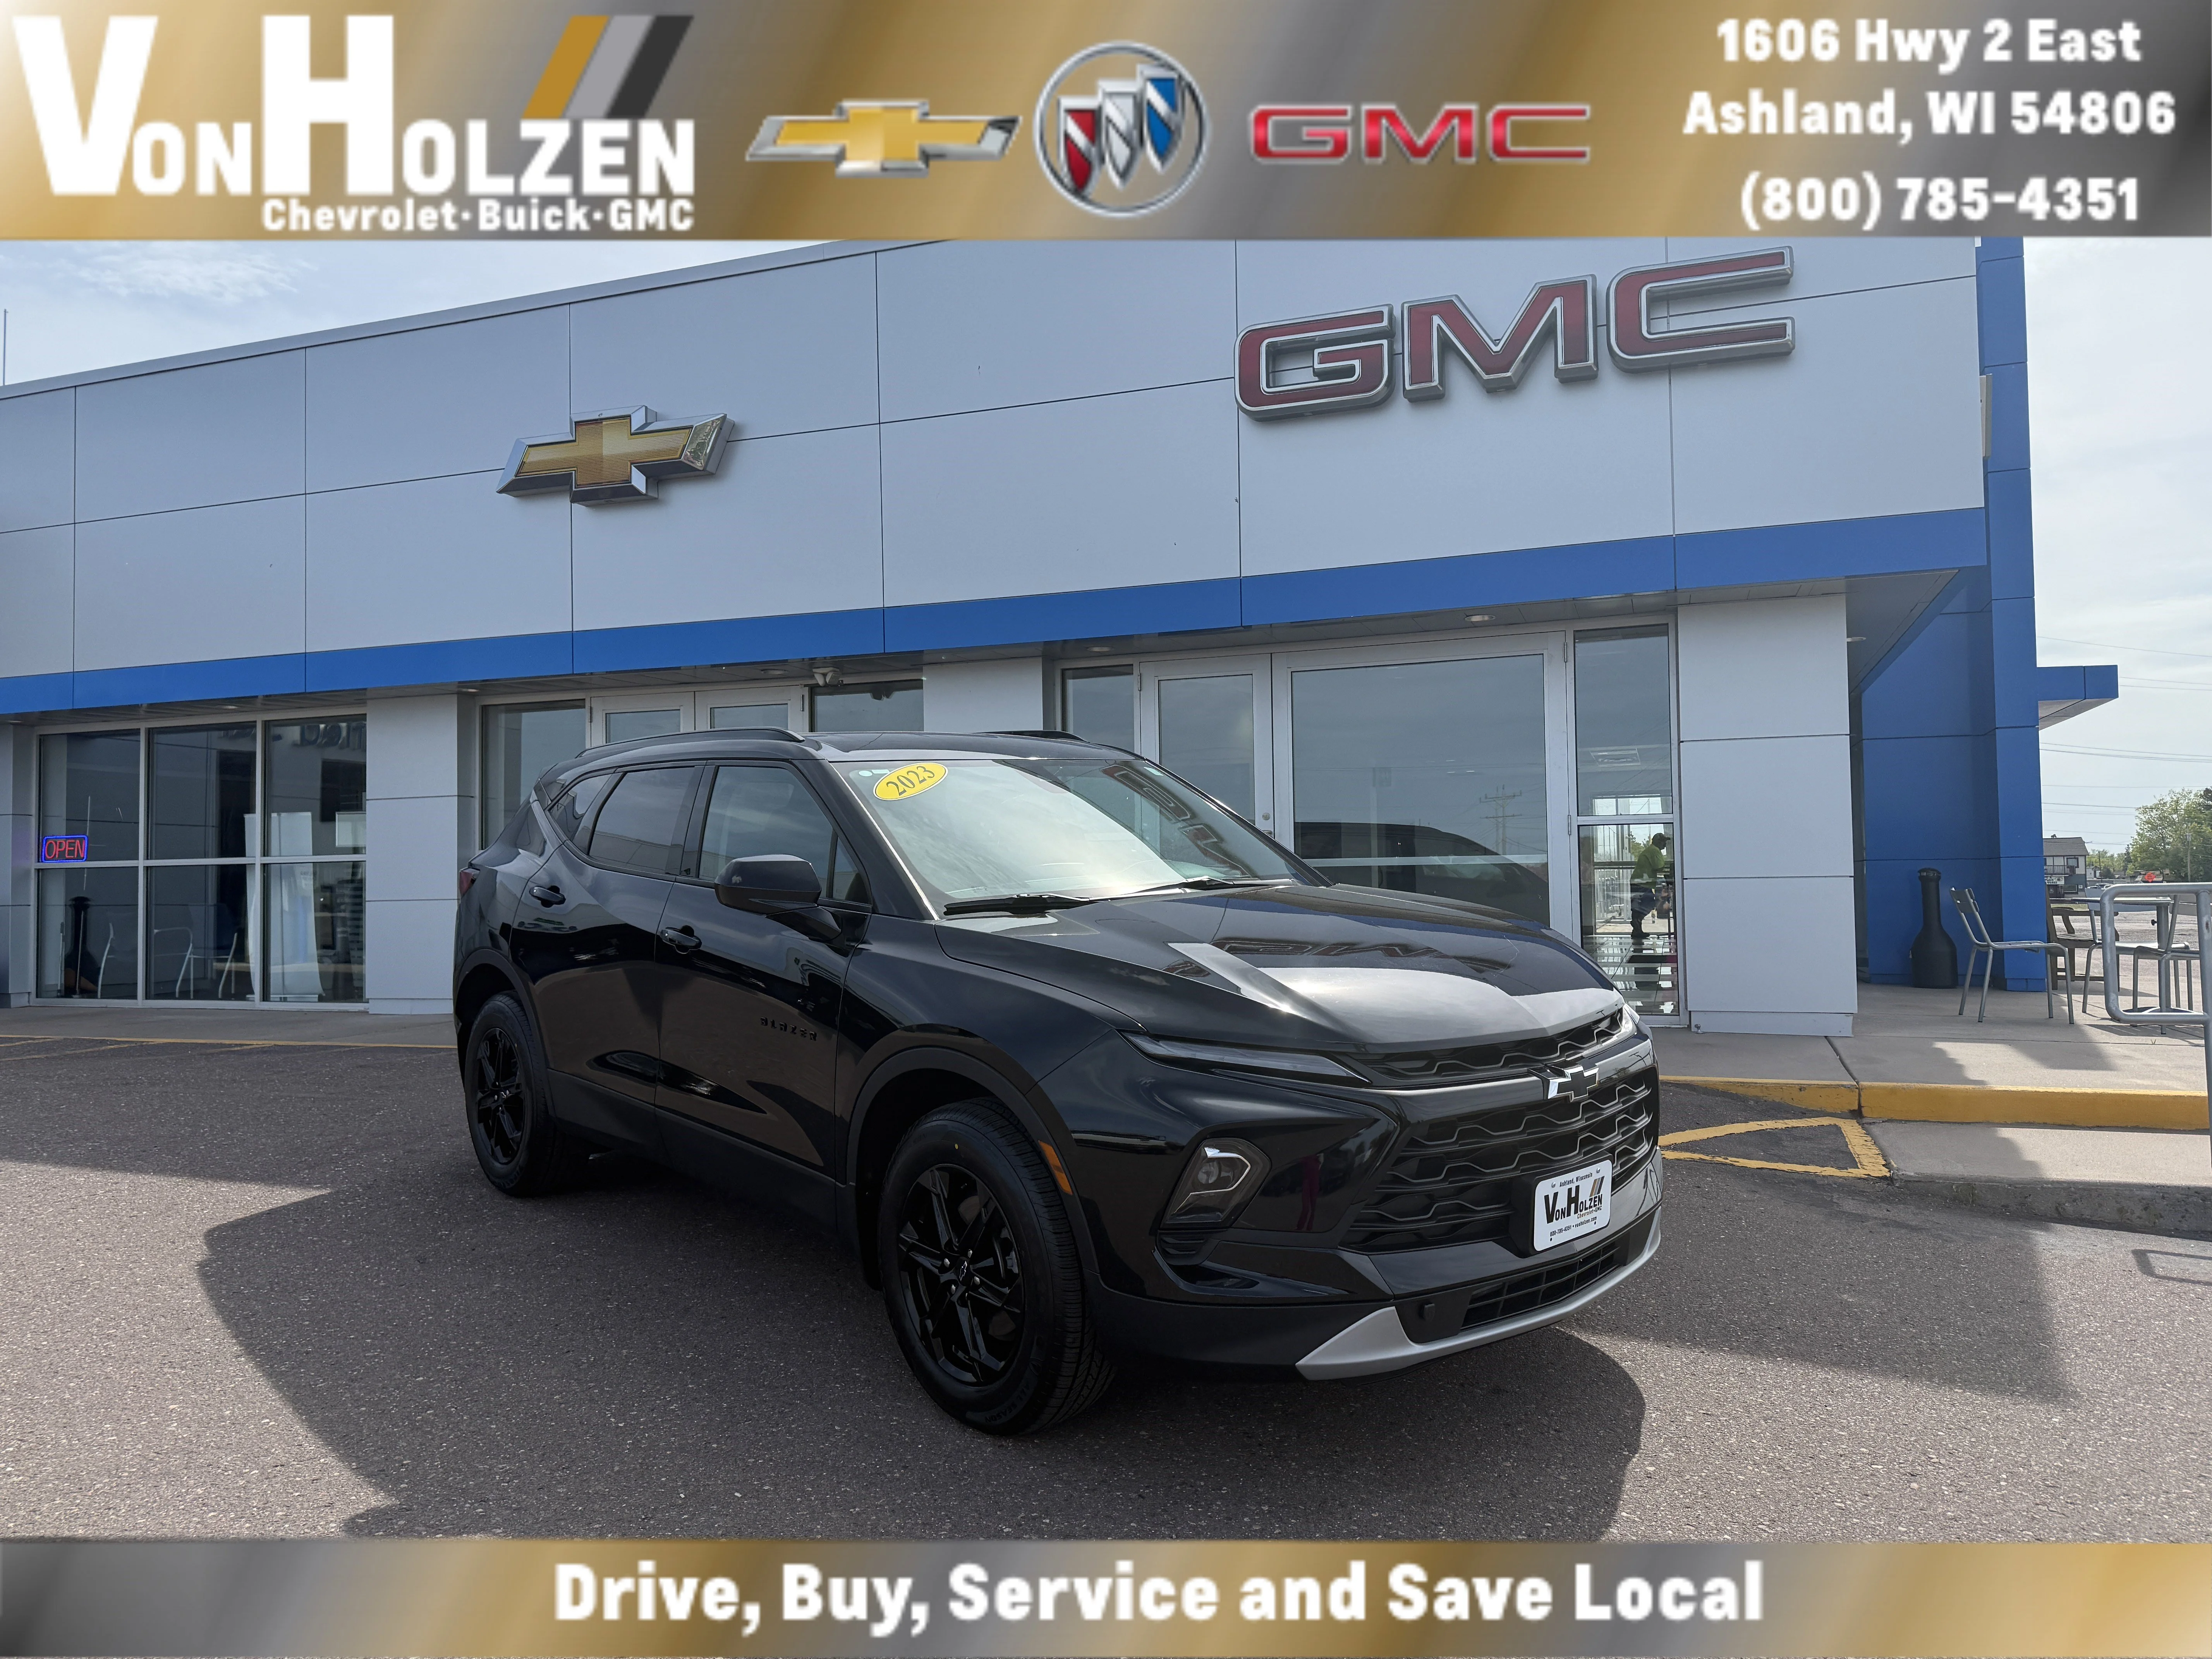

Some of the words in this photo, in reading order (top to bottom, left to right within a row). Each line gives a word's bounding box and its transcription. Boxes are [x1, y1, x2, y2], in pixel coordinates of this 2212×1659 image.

[1234, 246, 1795, 421] GMC
[886, 766, 935, 796] 2023
[45, 840, 85, 859] OPEN
[1575, 1172, 1593, 1182] Wisconsin
